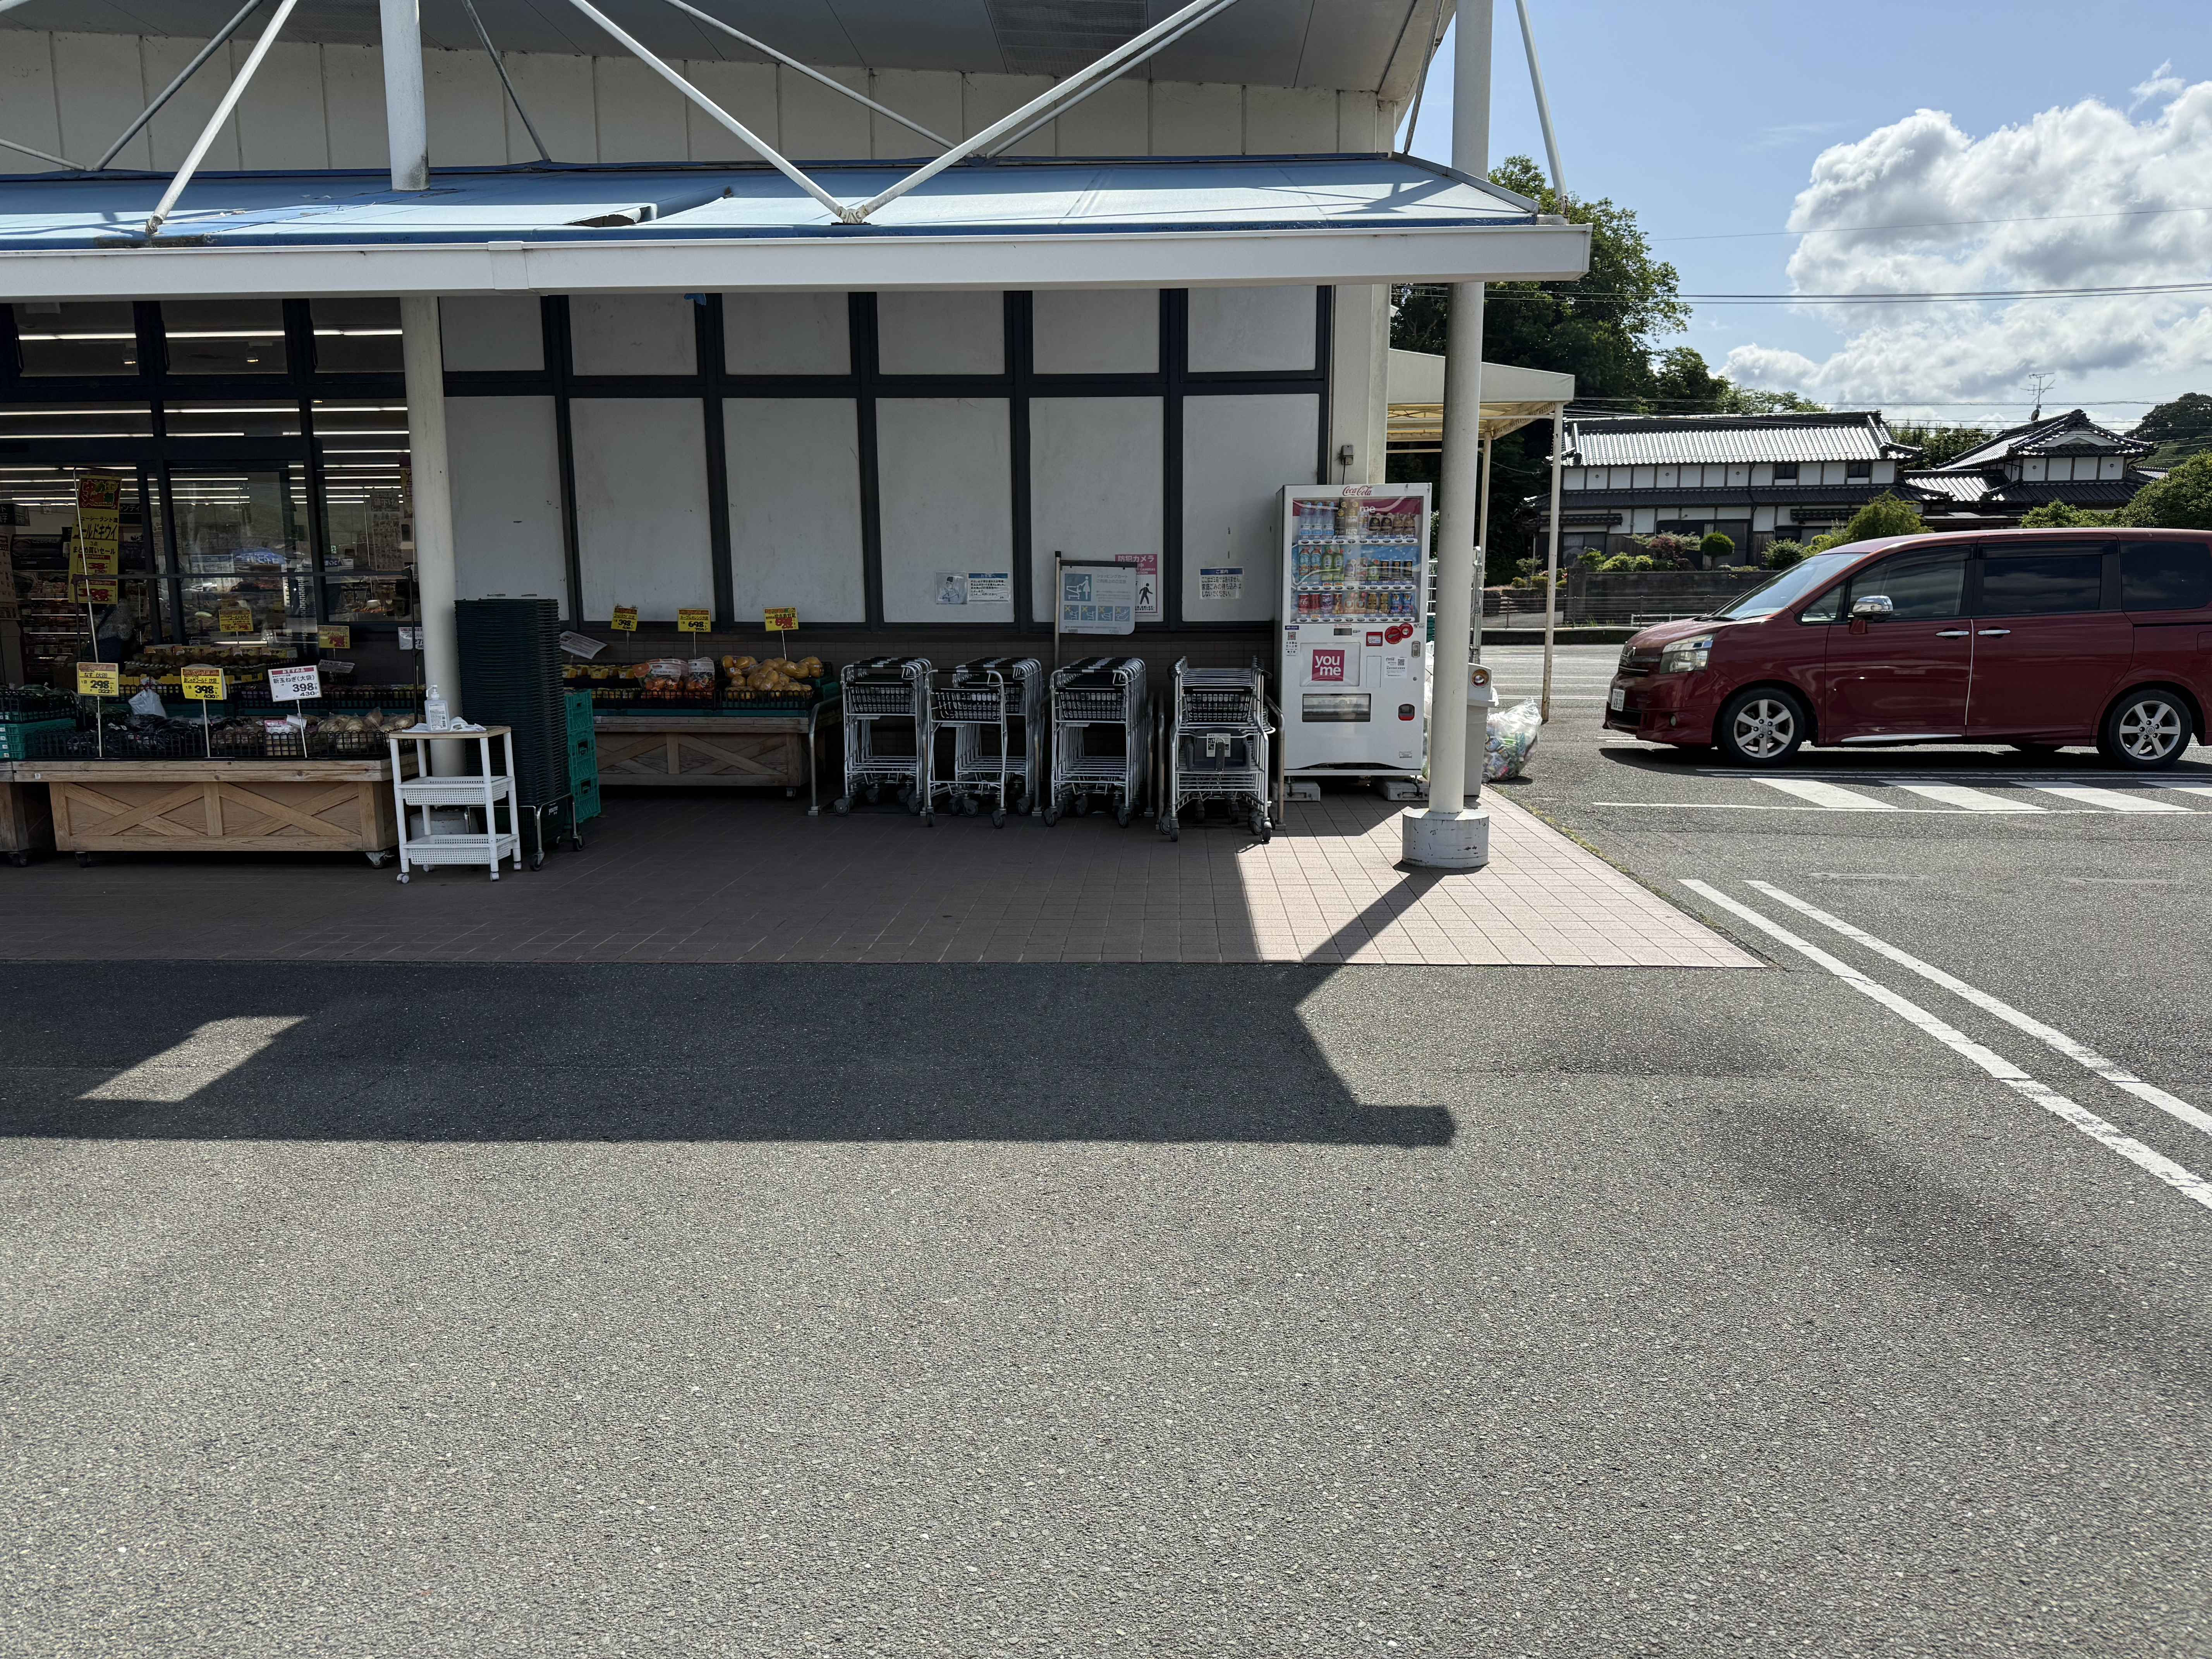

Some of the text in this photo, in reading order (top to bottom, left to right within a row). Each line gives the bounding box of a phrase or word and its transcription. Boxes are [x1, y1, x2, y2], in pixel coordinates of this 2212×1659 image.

[1342, 486, 1374, 496] Coca-Cola
[1315, 656, 1340, 668] you
[1320, 666, 1341, 676] me
[90, 680, 110, 689] 298
[292, 683, 314, 692] 398
[194, 685, 214, 694] 398
